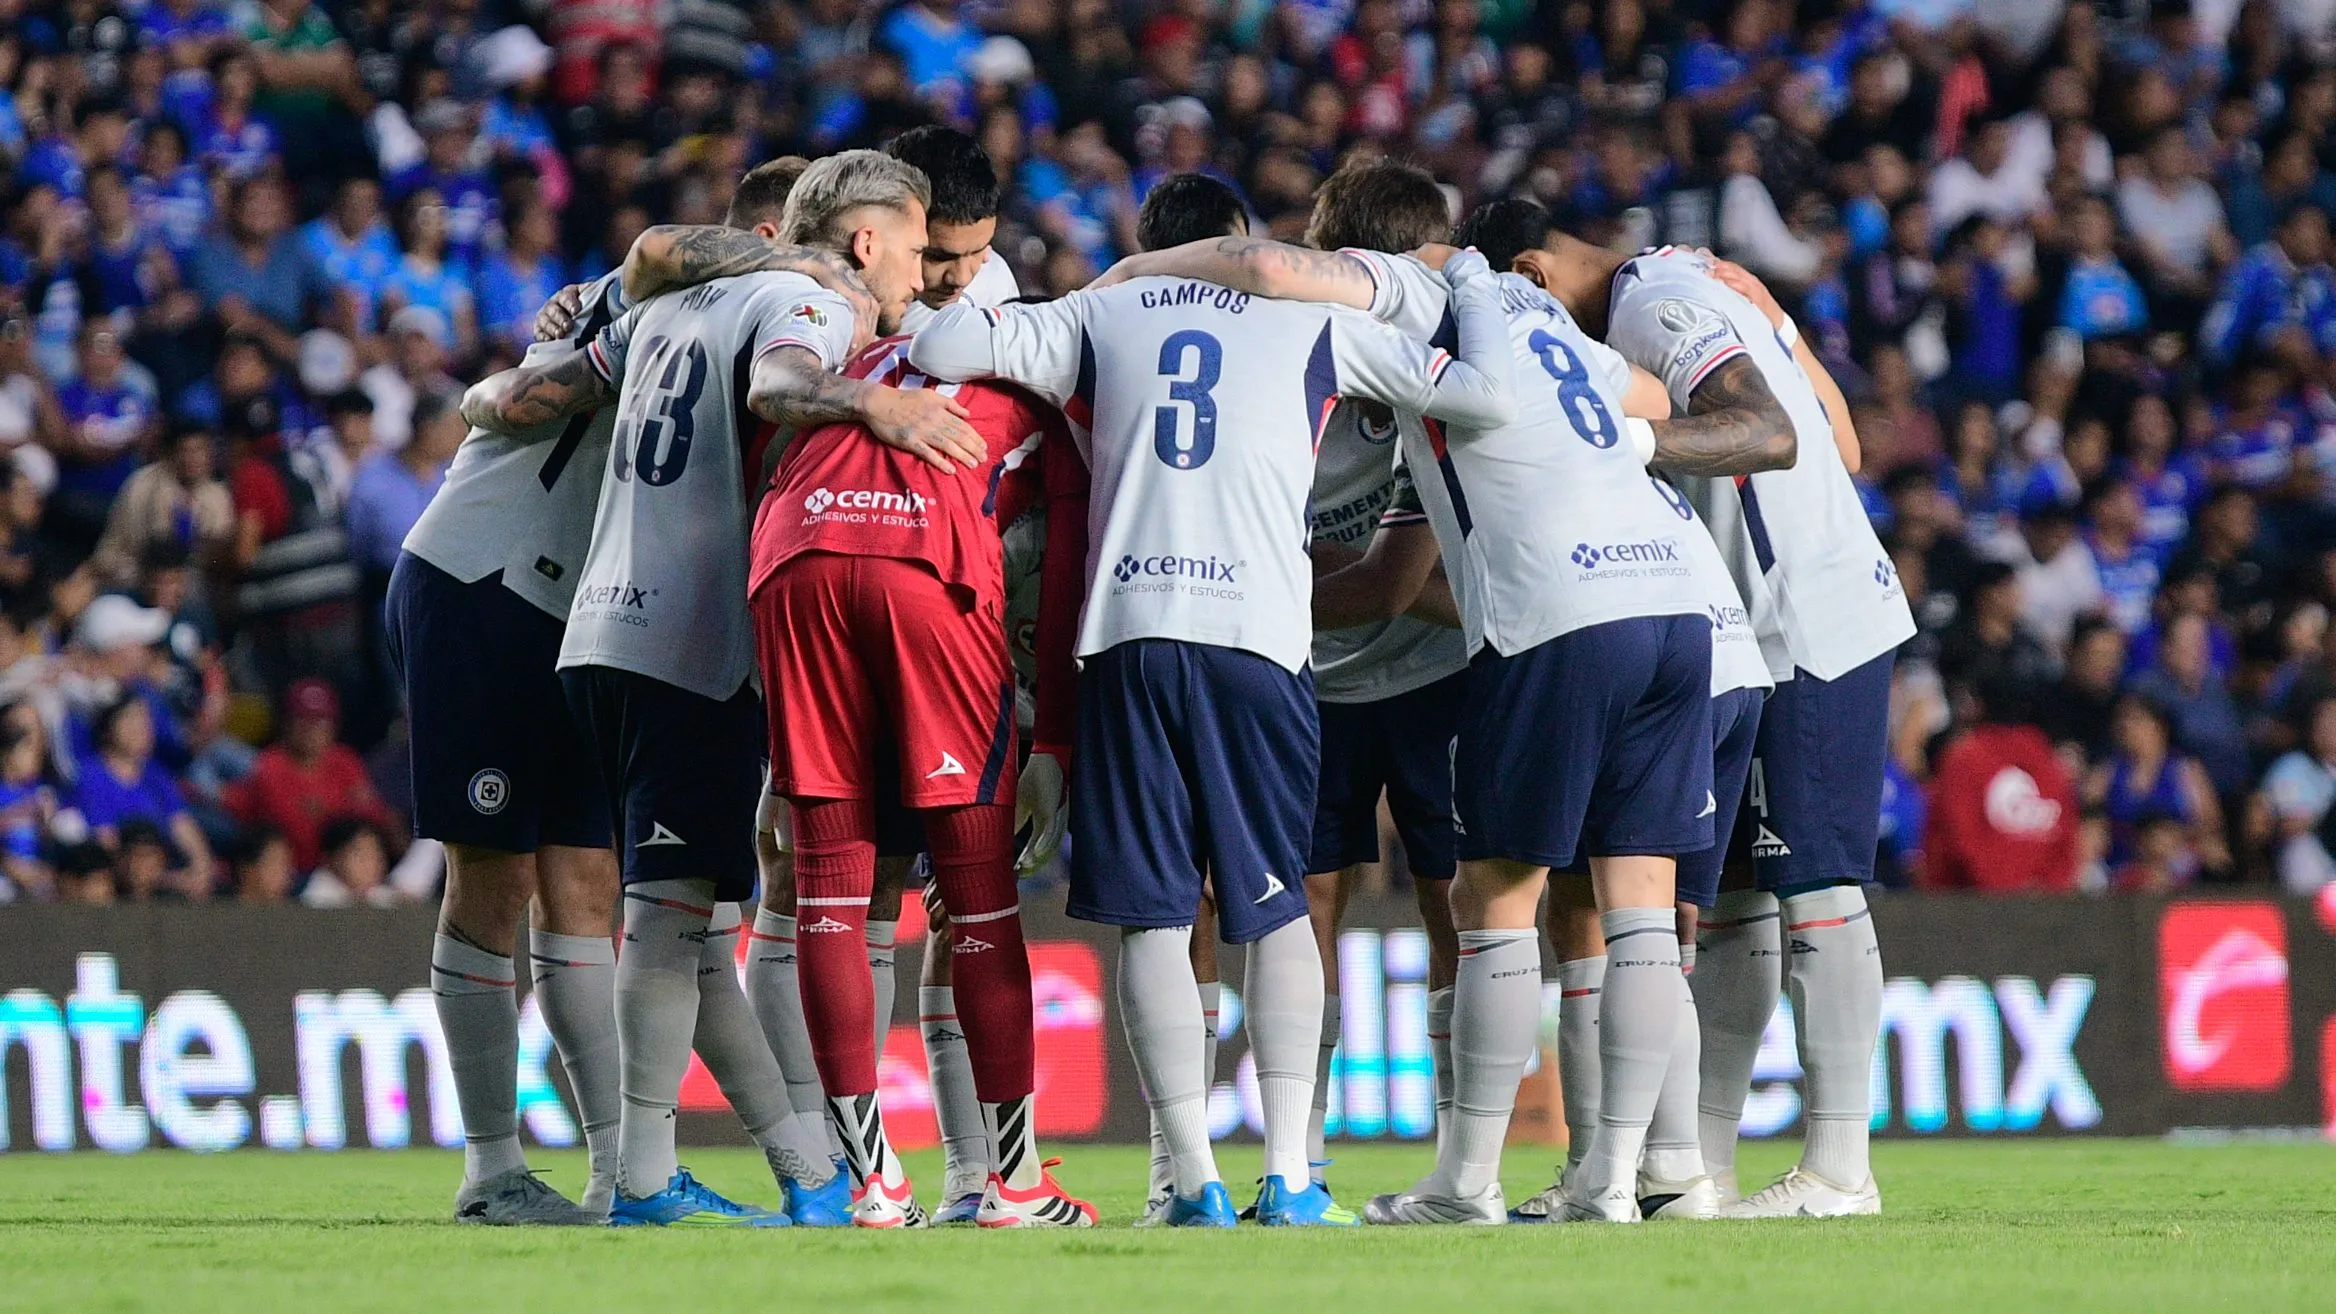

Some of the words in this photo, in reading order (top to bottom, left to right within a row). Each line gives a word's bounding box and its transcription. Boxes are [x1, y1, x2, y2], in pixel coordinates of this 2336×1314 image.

[1140, 283, 1251, 315] CAMPOS
[1154, 329, 1223, 470] 3
[1528, 328, 1619, 449] 8
[836, 487, 926, 513] cemix
[1312, 479, 1397, 531] CEMENT
[801, 511, 867, 527] ADHESIVOS
[871, 513, 880, 524] Y
[1603, 539, 1678, 563] cemix
[1143, 555, 1235, 583] cemix
[1112, 582, 1175, 598] ADHESIVOS
[1180, 584, 1188, 593] Y
[1190, 586, 1245, 602] ESTUCOS
